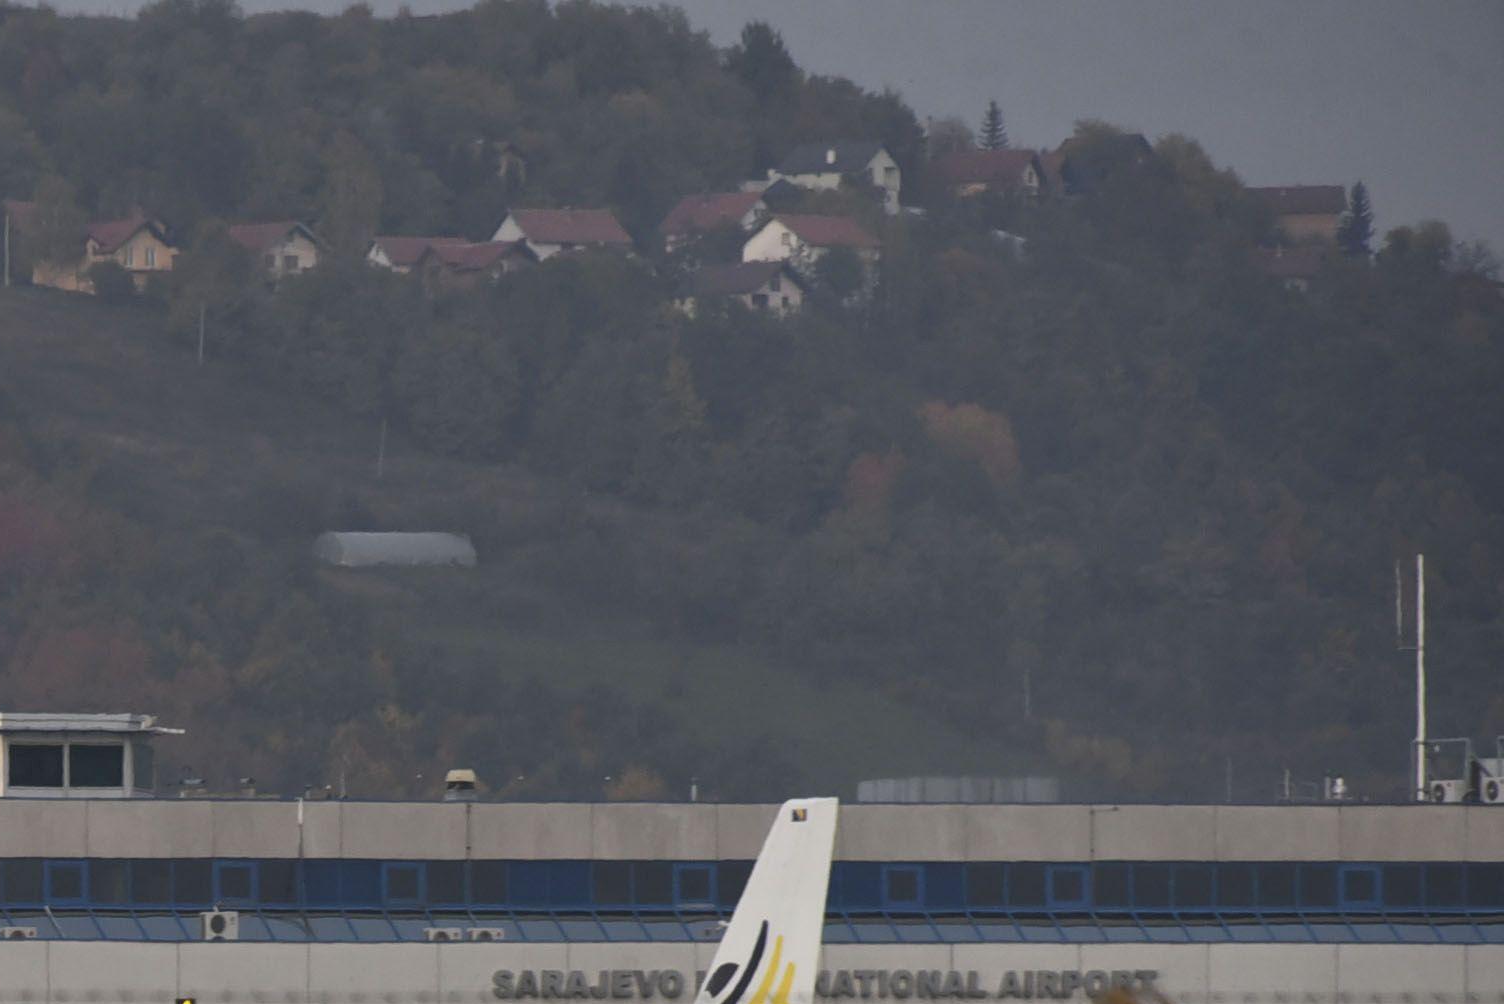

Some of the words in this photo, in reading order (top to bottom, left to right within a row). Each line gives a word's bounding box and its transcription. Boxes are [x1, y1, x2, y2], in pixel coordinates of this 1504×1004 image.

[492, 969, 685, 999] SARAJEVO
[695, 969, 987, 999] INATIONAL
[997, 969, 1158, 999] AIRPORT
